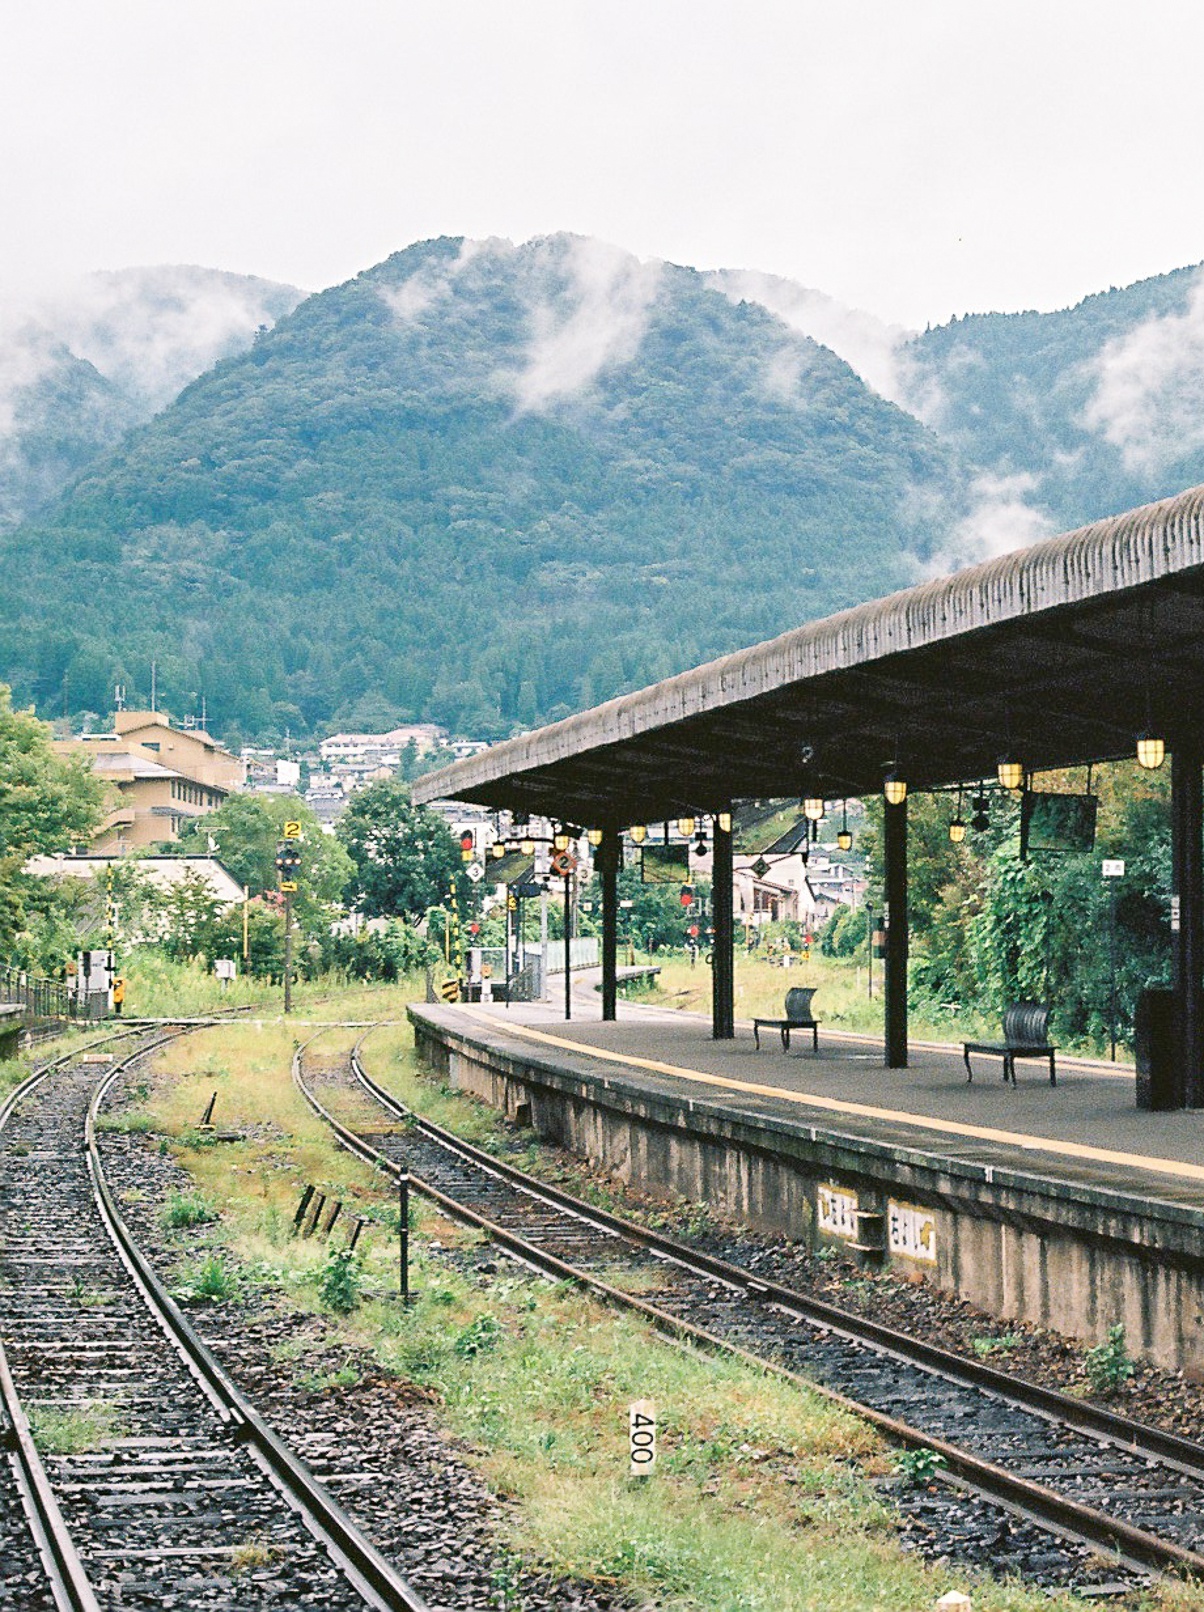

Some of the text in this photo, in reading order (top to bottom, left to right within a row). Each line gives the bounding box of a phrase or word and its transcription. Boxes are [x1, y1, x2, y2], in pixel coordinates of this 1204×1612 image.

[287, 822, 300, 836] 2
[559, 855, 569, 869] 2
[630, 1413, 655, 1464] 400
